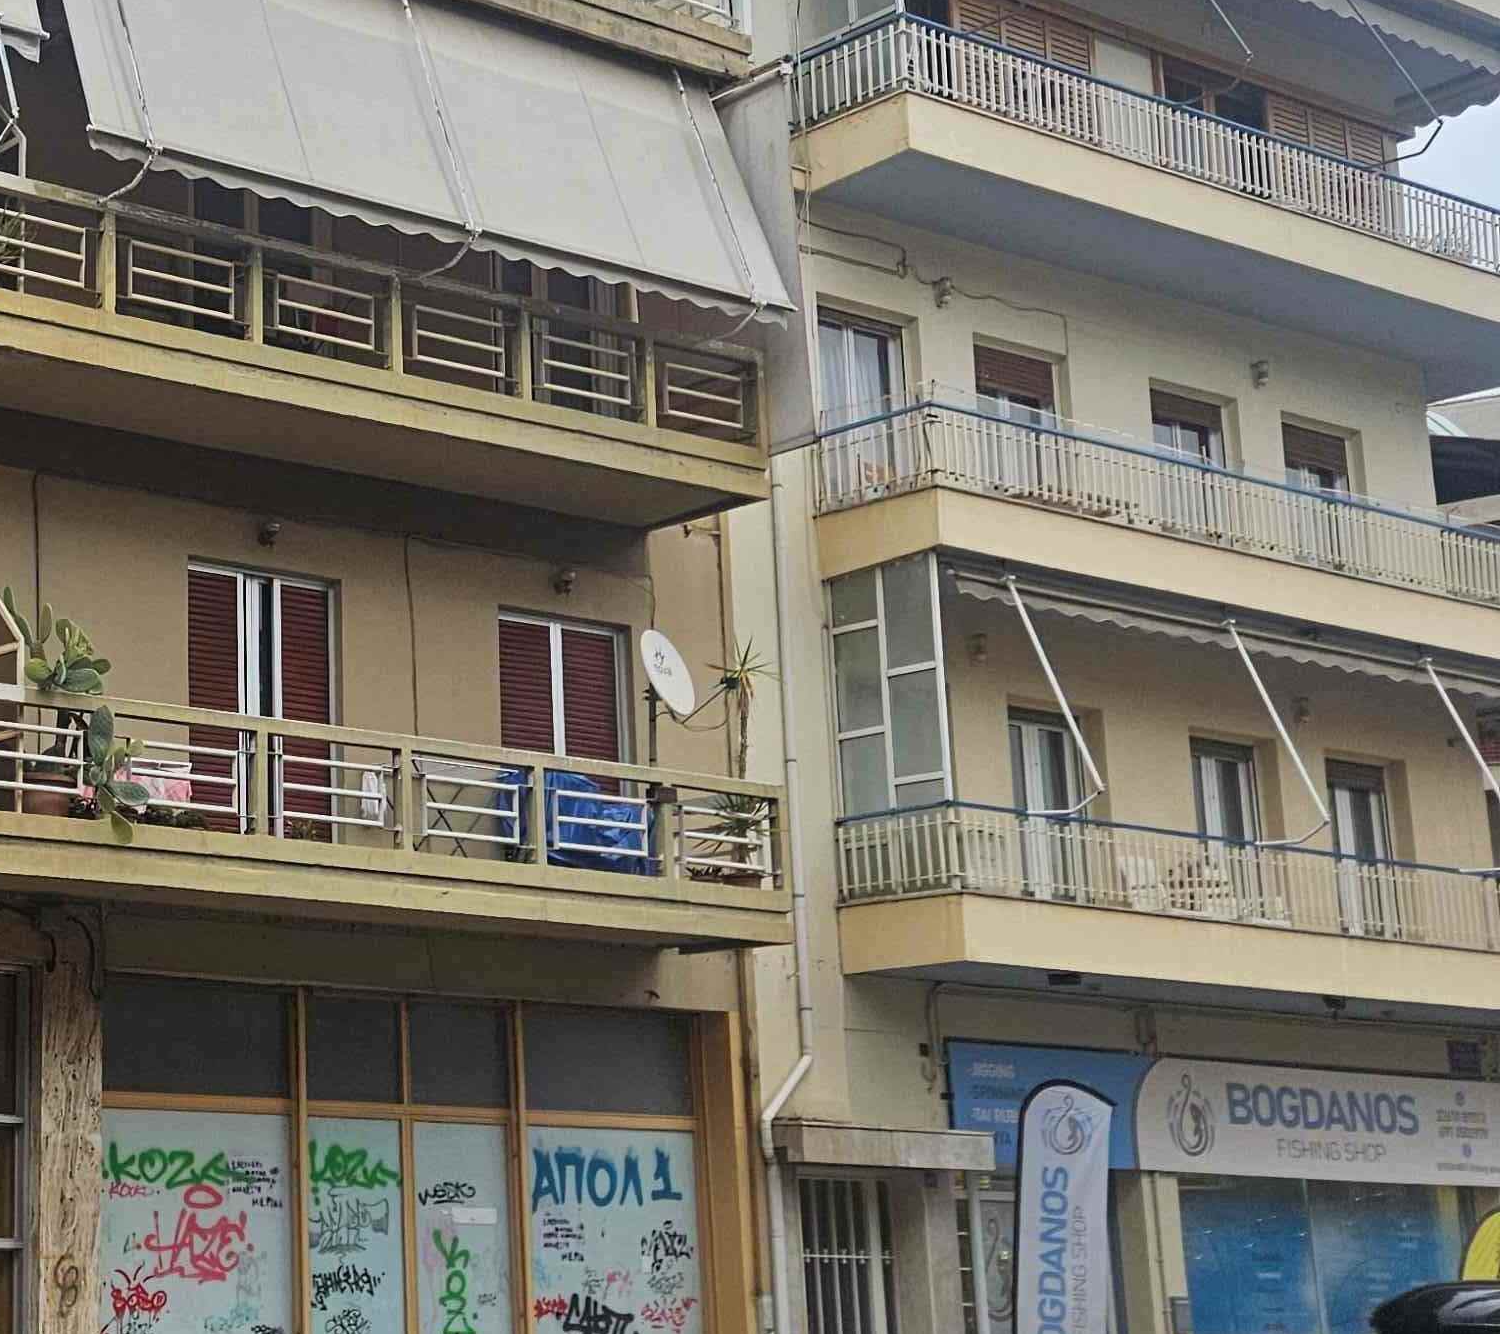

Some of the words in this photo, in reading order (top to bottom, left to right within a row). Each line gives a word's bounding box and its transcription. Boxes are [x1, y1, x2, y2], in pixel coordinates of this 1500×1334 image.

[1226, 1082, 1420, 1136] BOGDANOS
[1277, 1138, 1342, 1162] FISHING
[1345, 1142, 1387, 1163] SHOP
[1072, 1205, 1088, 1260] SHOP
